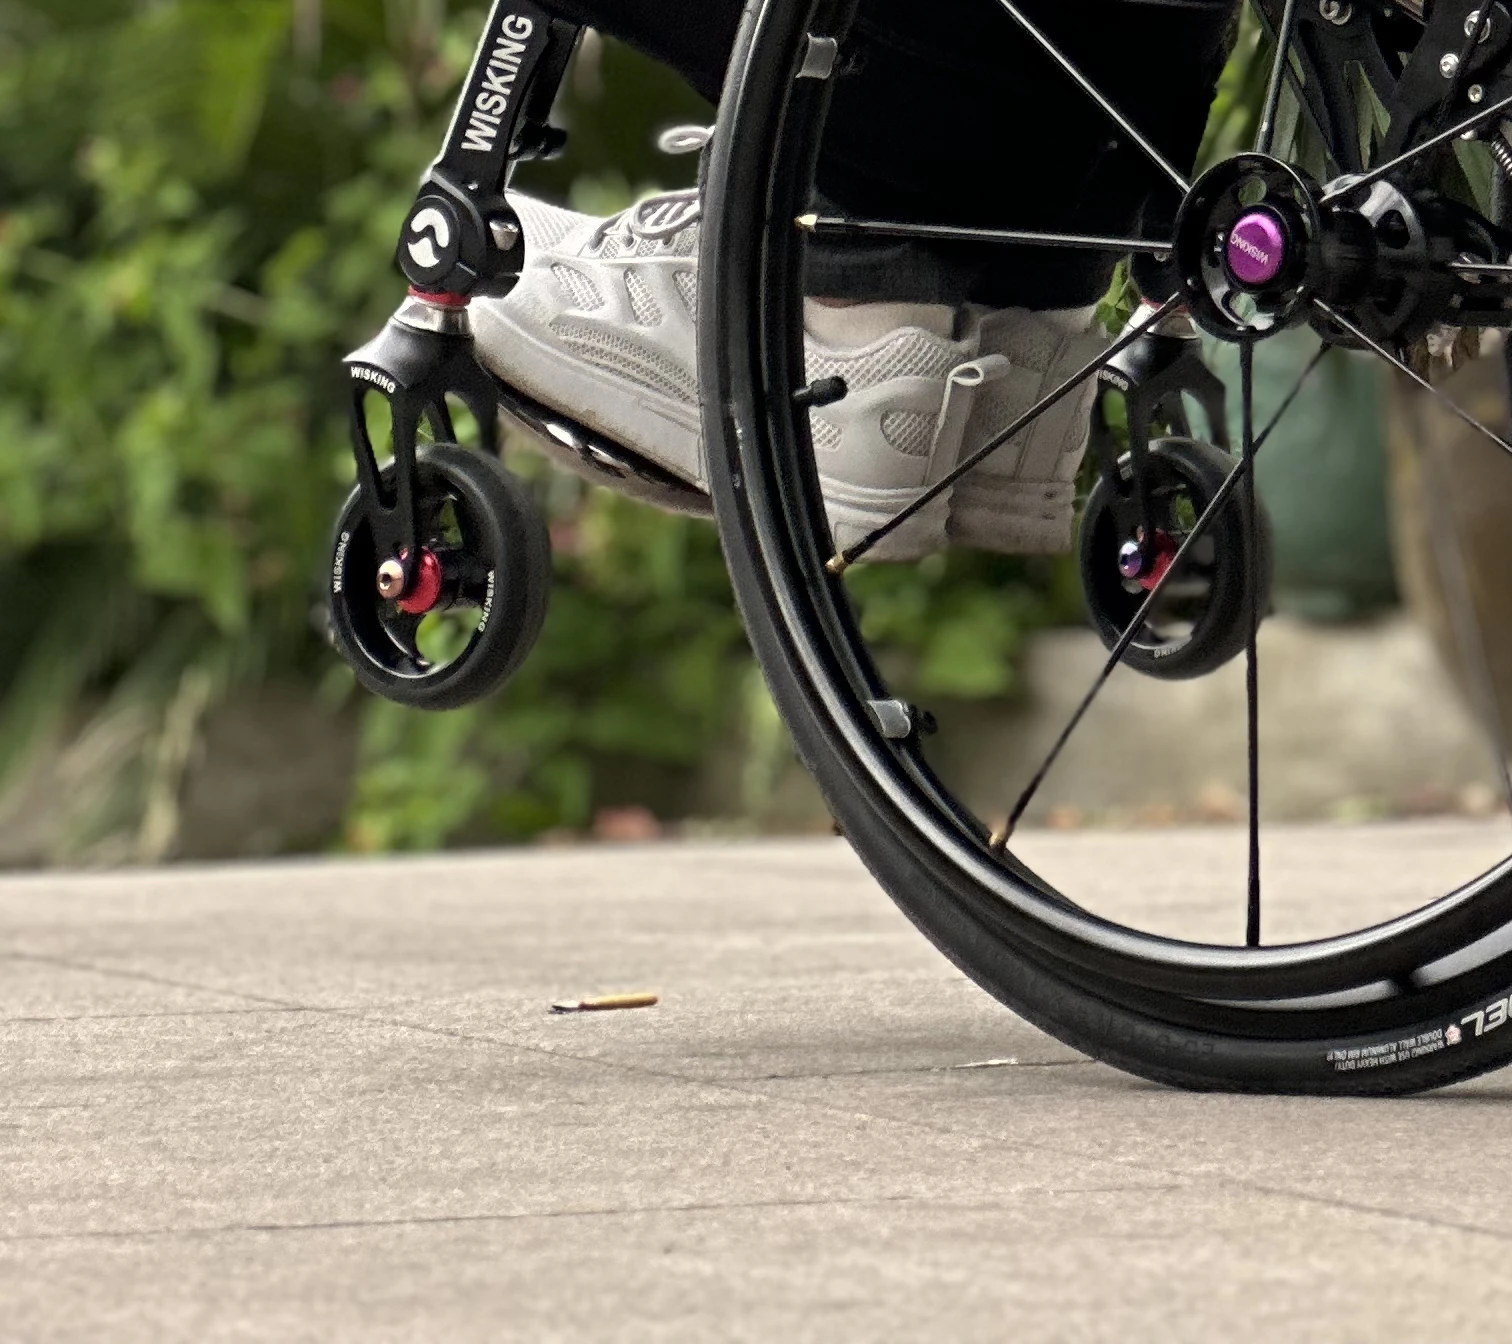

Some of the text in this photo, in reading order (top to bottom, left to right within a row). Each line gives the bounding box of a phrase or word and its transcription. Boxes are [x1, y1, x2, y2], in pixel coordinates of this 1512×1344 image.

[461, 13, 533, 153] WISKING
[1230, 232, 1270, 265] WISKING
[350, 365, 397, 394] WISKING
[332, 530, 351, 594] WISKING
[477, 569, 496, 633] WISKING
